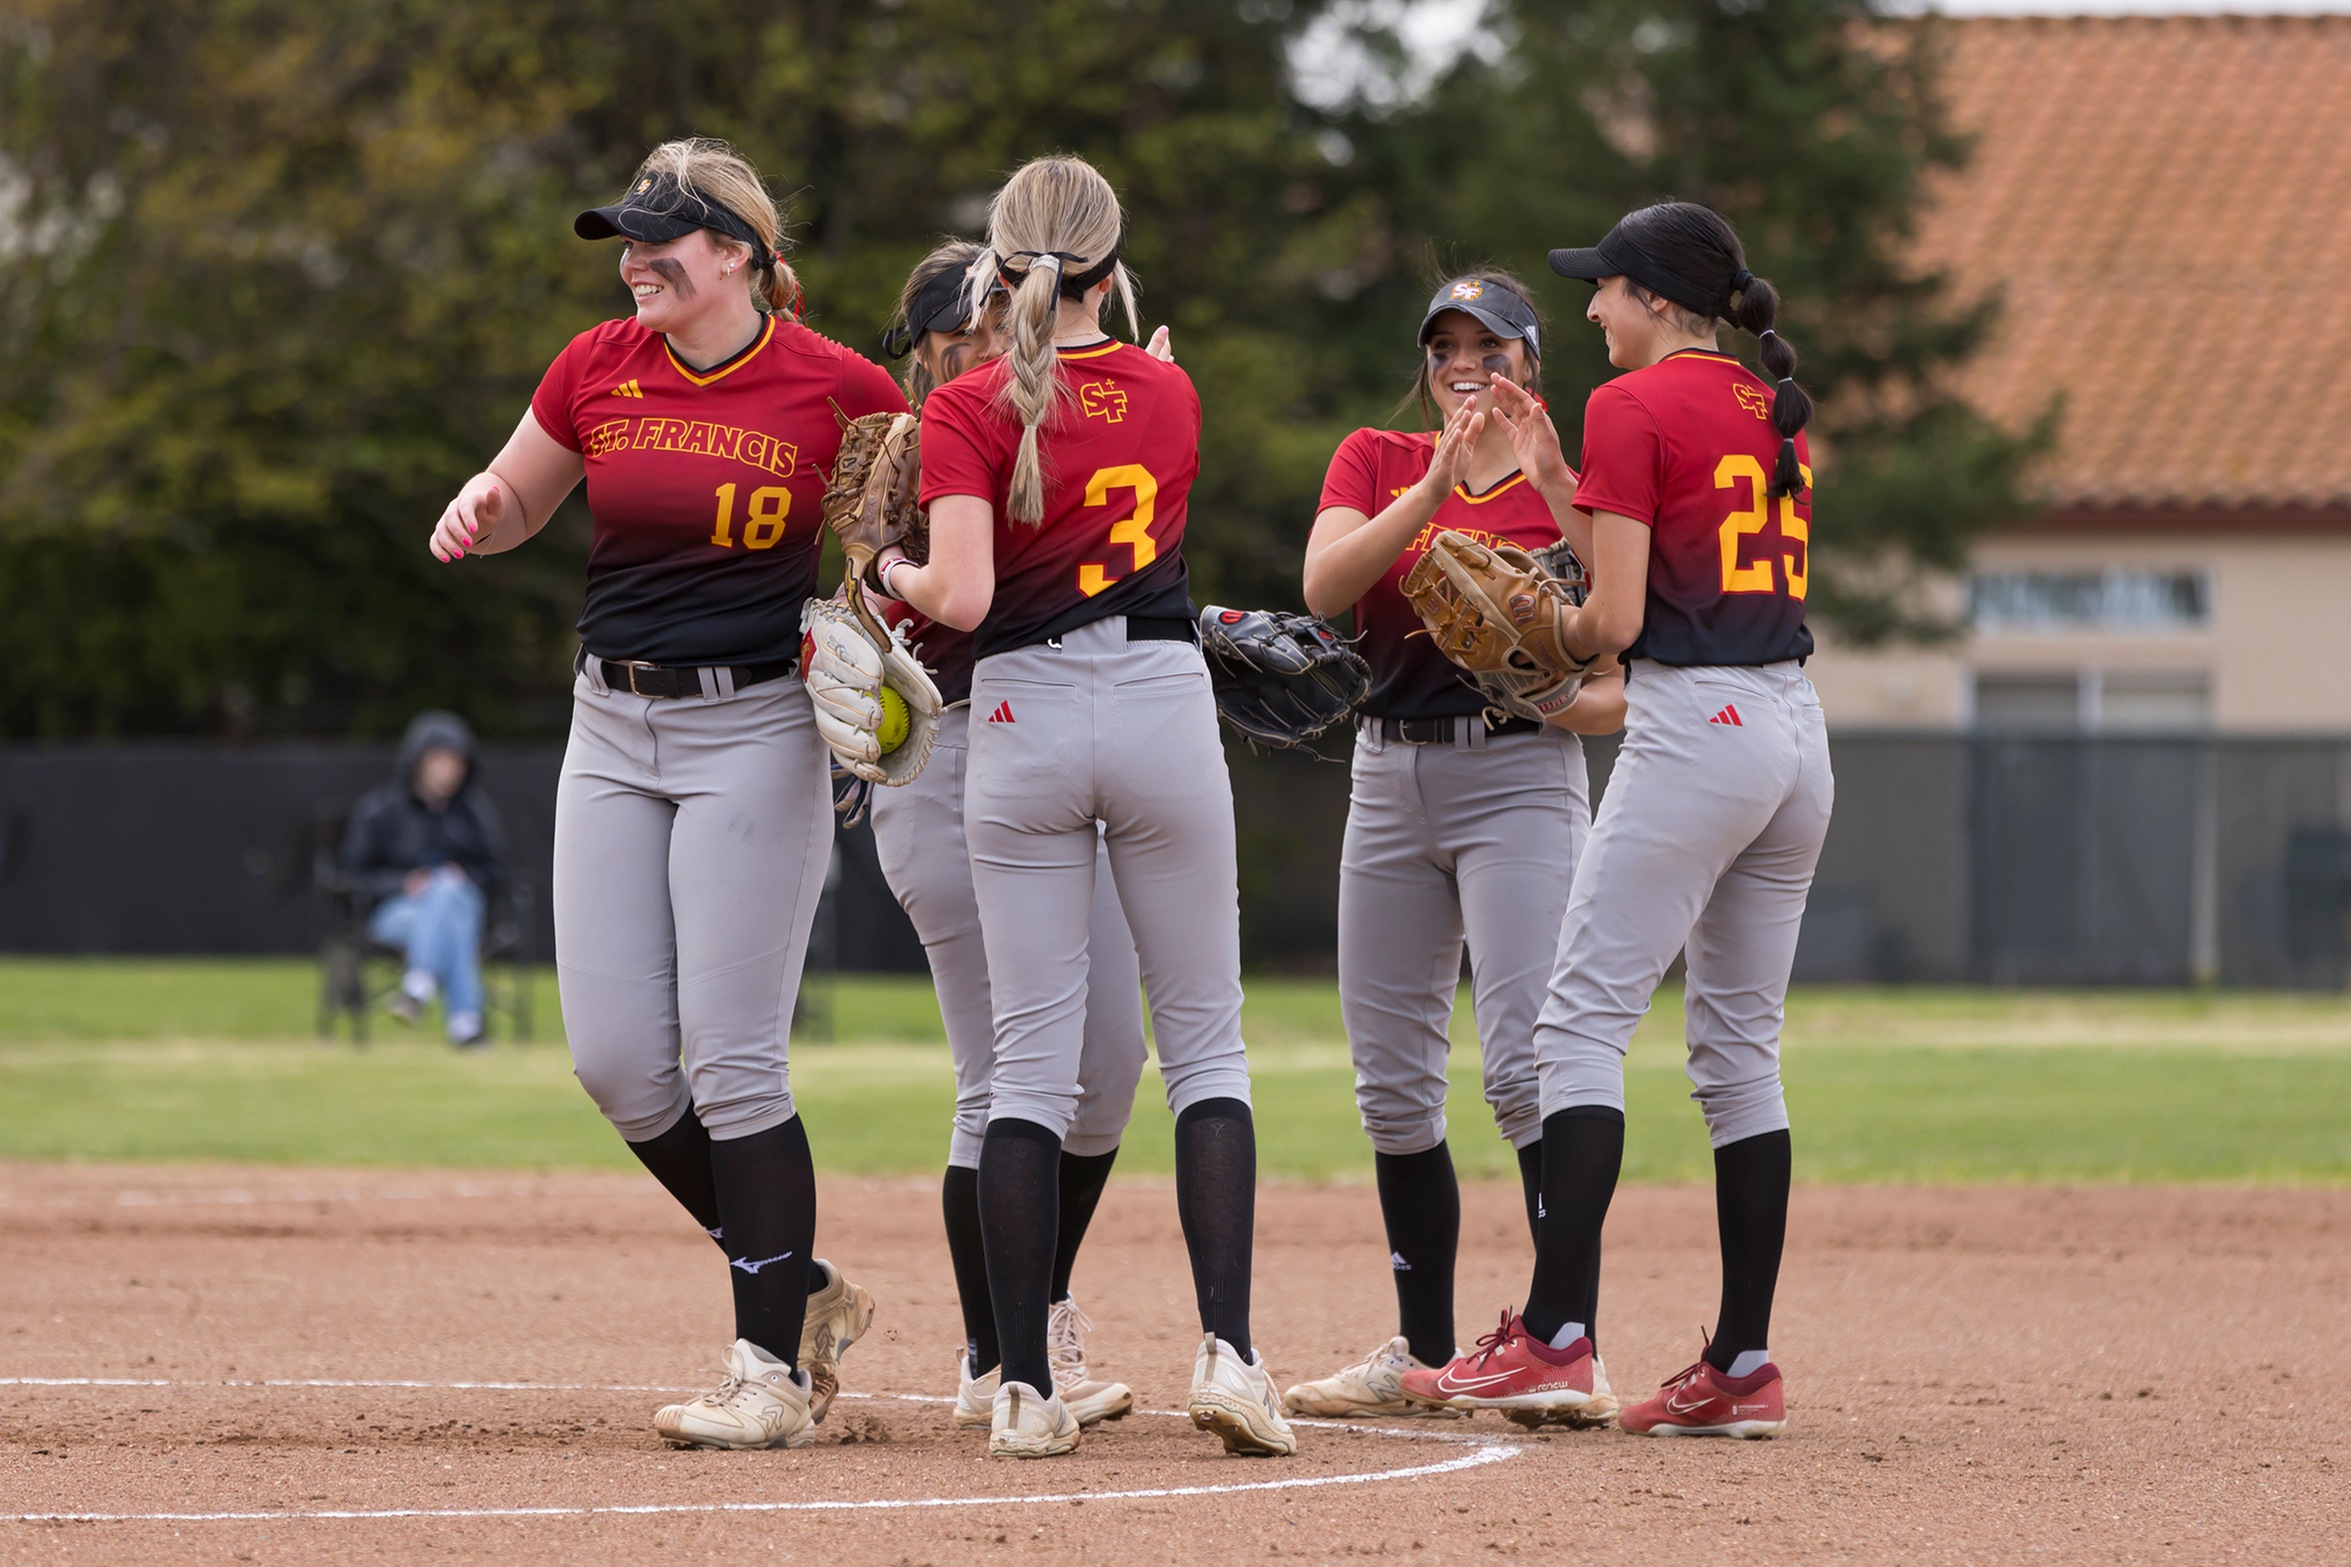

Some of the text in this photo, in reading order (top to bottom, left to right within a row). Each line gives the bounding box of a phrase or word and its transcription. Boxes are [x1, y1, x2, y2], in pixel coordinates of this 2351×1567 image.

[1450, 281, 1483, 300] SF
[1080, 382, 1128, 423] SF
[1733, 383, 1767, 420] SF
[590, 418, 798, 478] ST. FRANCIS
[711, 482, 792, 549] 18
[1076, 463, 1158, 598] 3
[1713, 454, 1813, 602] 25
